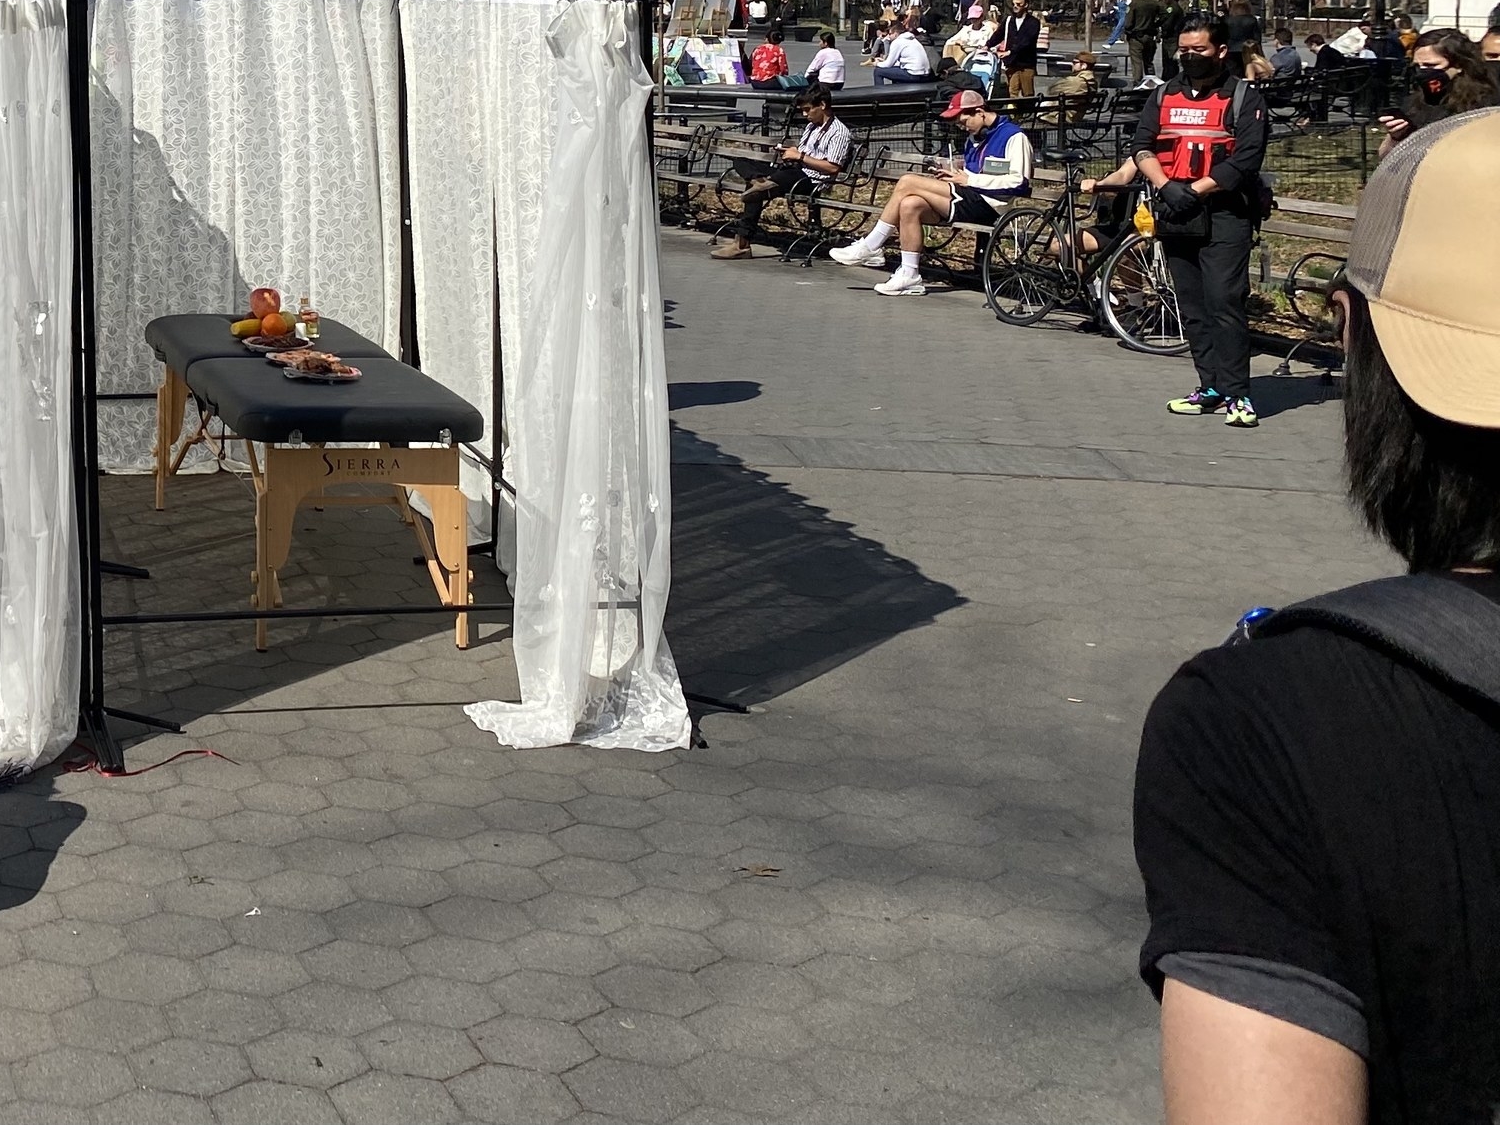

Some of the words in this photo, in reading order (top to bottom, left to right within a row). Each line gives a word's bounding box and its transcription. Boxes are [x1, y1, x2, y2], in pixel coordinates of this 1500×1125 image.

[1169, 107, 1209, 117] STREET
[1169, 116, 1206, 125] MEDIC
[322, 452, 400, 476] SIERRA
